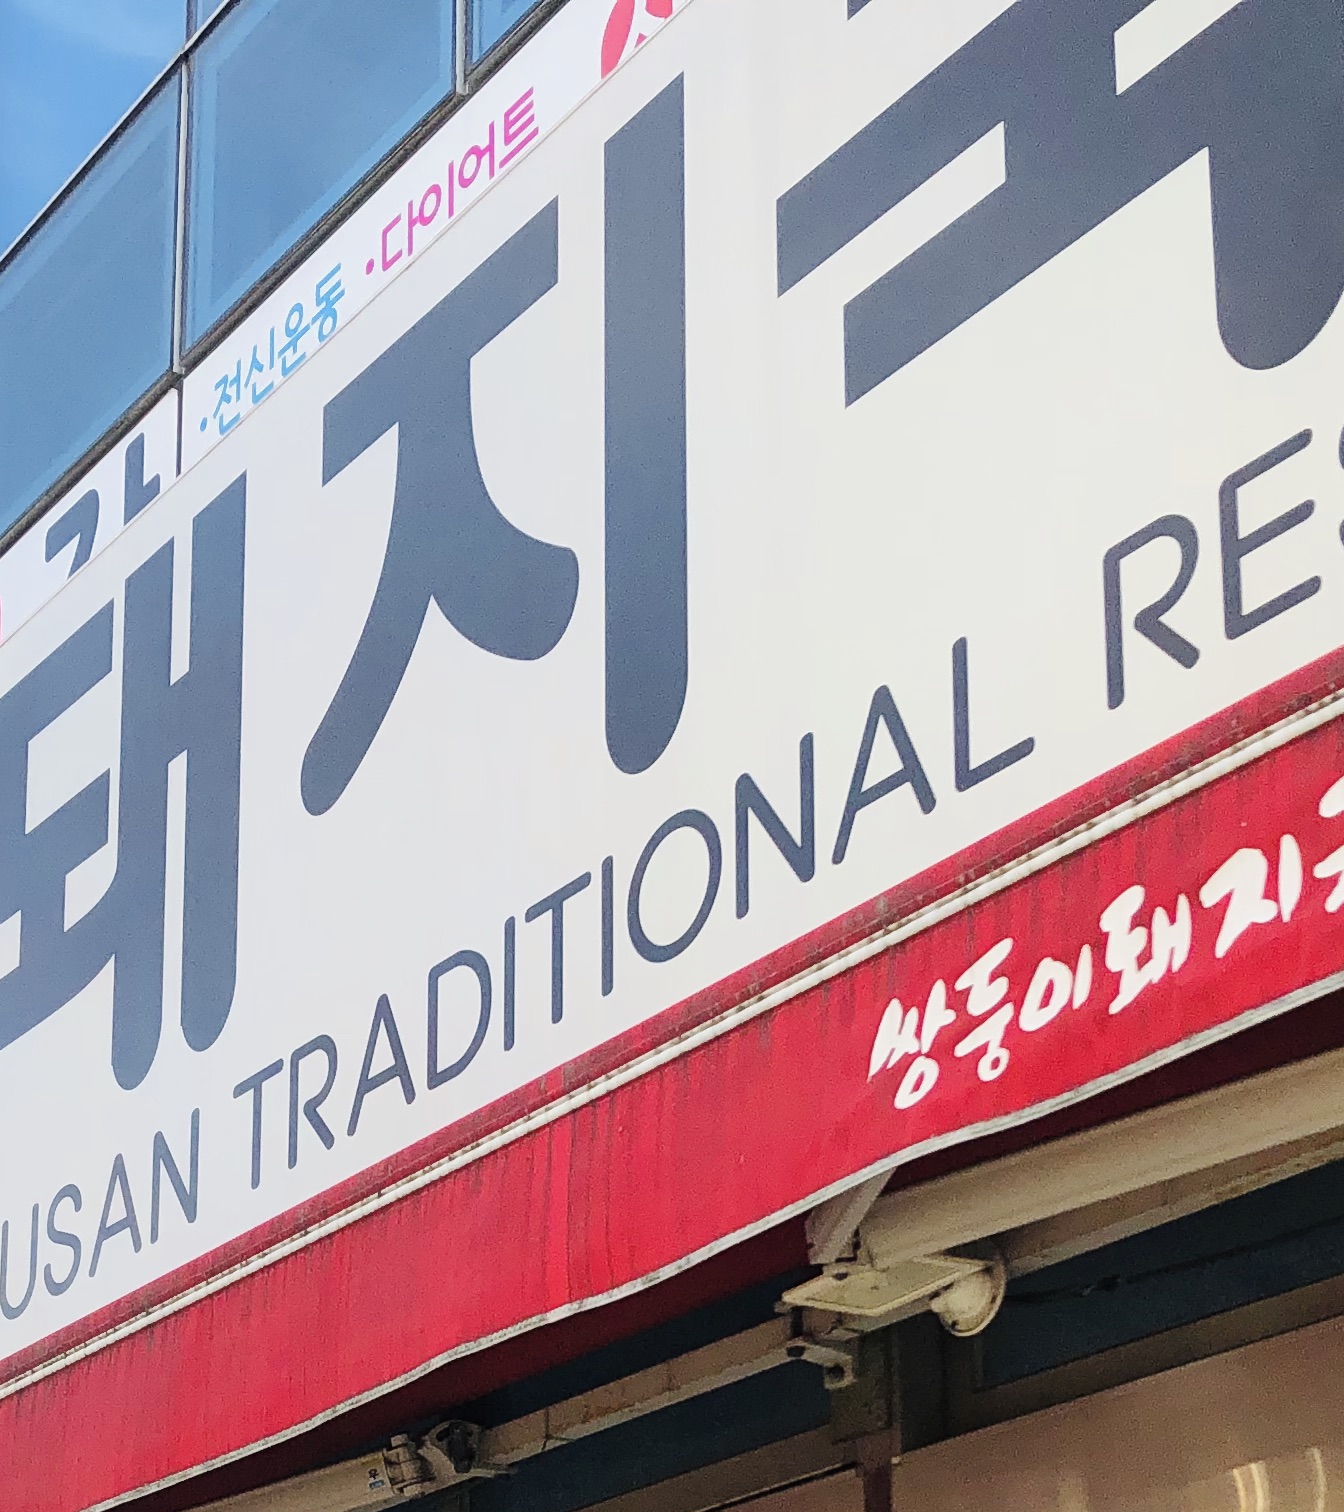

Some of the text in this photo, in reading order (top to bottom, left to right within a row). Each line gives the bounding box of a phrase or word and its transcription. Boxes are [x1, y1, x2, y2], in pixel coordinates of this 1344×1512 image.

[380, 86, 540, 272] 다이어트
[213, 262, 345, 436] 전신운동
[231, 637, 1036, 1190] TRADITIONAL
